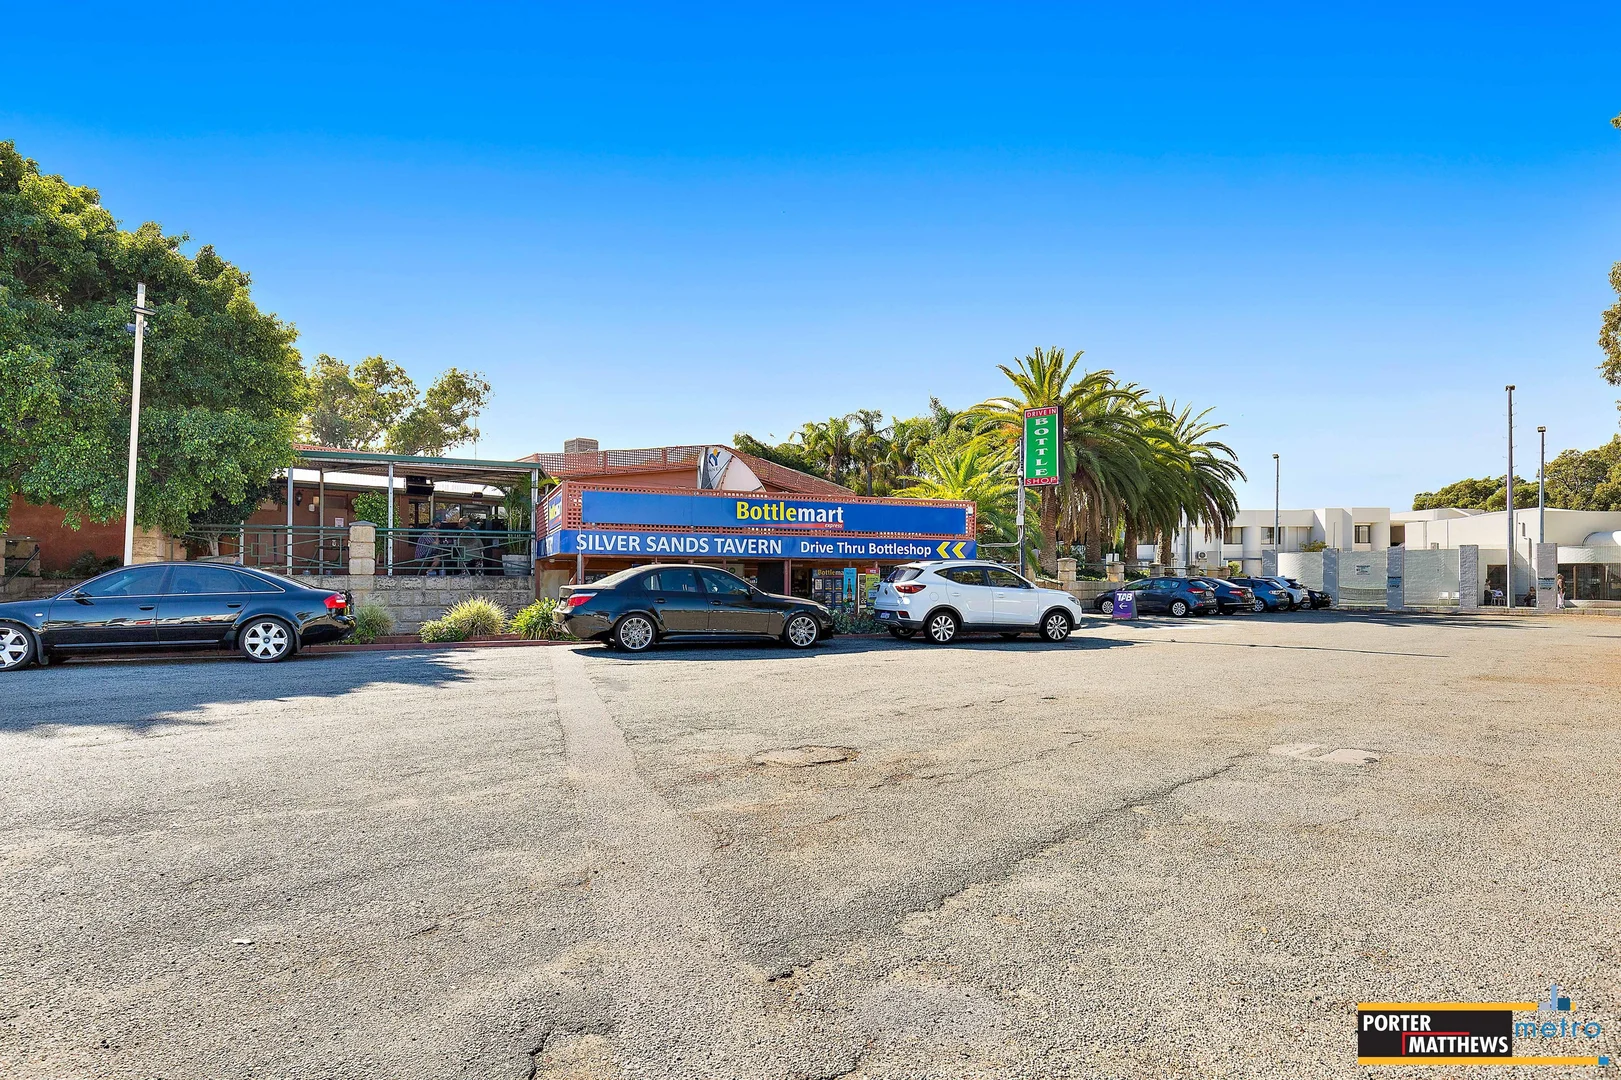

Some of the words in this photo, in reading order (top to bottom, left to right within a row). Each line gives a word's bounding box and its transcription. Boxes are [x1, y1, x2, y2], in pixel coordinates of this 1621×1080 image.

[1027, 410, 1047, 418] DRIVE
[1034, 417, 1050, 476] BOTTLE
[1026, 477, 1057, 485] SHOP
[736, 501, 845, 523] Bottlemart
[576, 533, 641, 551] SILVER
[646, 536, 709, 553] SANDS
[714, 538, 782, 554] TAVERN
[801, 541, 834, 553] Drive
[837, 542, 865, 554] Thru
[869, 543, 932, 558] Bottleshop
[1116, 593, 1133, 602] TAB
